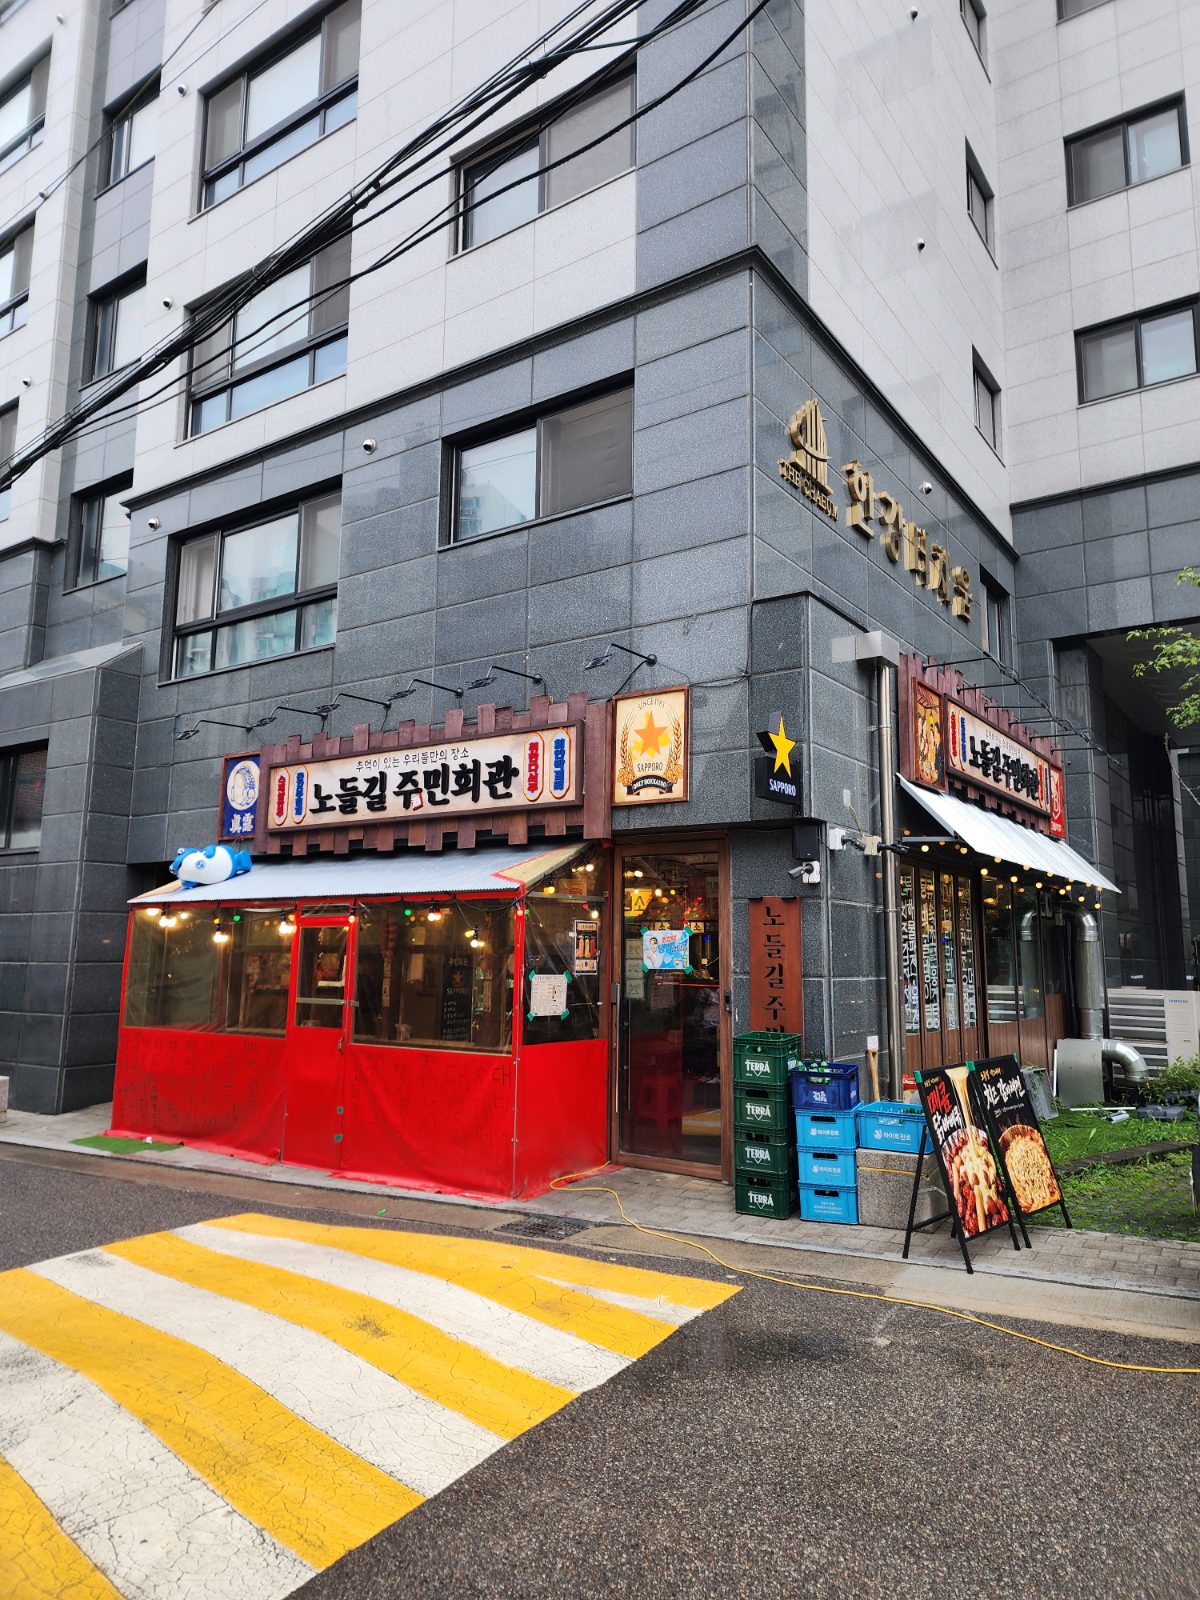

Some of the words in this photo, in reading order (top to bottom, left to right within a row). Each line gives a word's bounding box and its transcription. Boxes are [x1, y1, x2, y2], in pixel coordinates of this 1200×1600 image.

[356, 758, 380, 773] 추억이
[383, 757, 399, 770] 있는
[403, 749, 448, 766] 우리들만의
[451, 747, 470, 761] 장소
[637, 762, 663, 772] SAPPORO
[309, 770, 388, 815] 노들길
[393, 755, 519, 811] 주민회관
[769, 778, 796, 797] SAPPORO
[744, 1058, 771, 1074] TERRA
[927, 1080, 952, 1114] 매콤
[745, 1102, 772, 1118] TERRA
[817, 1129, 840, 1137] 하이트진로
[883, 1132, 912, 1141] 하이트진로
[745, 1146, 771, 1162] TERRA
[748, 1190, 774, 1206] TERRA
